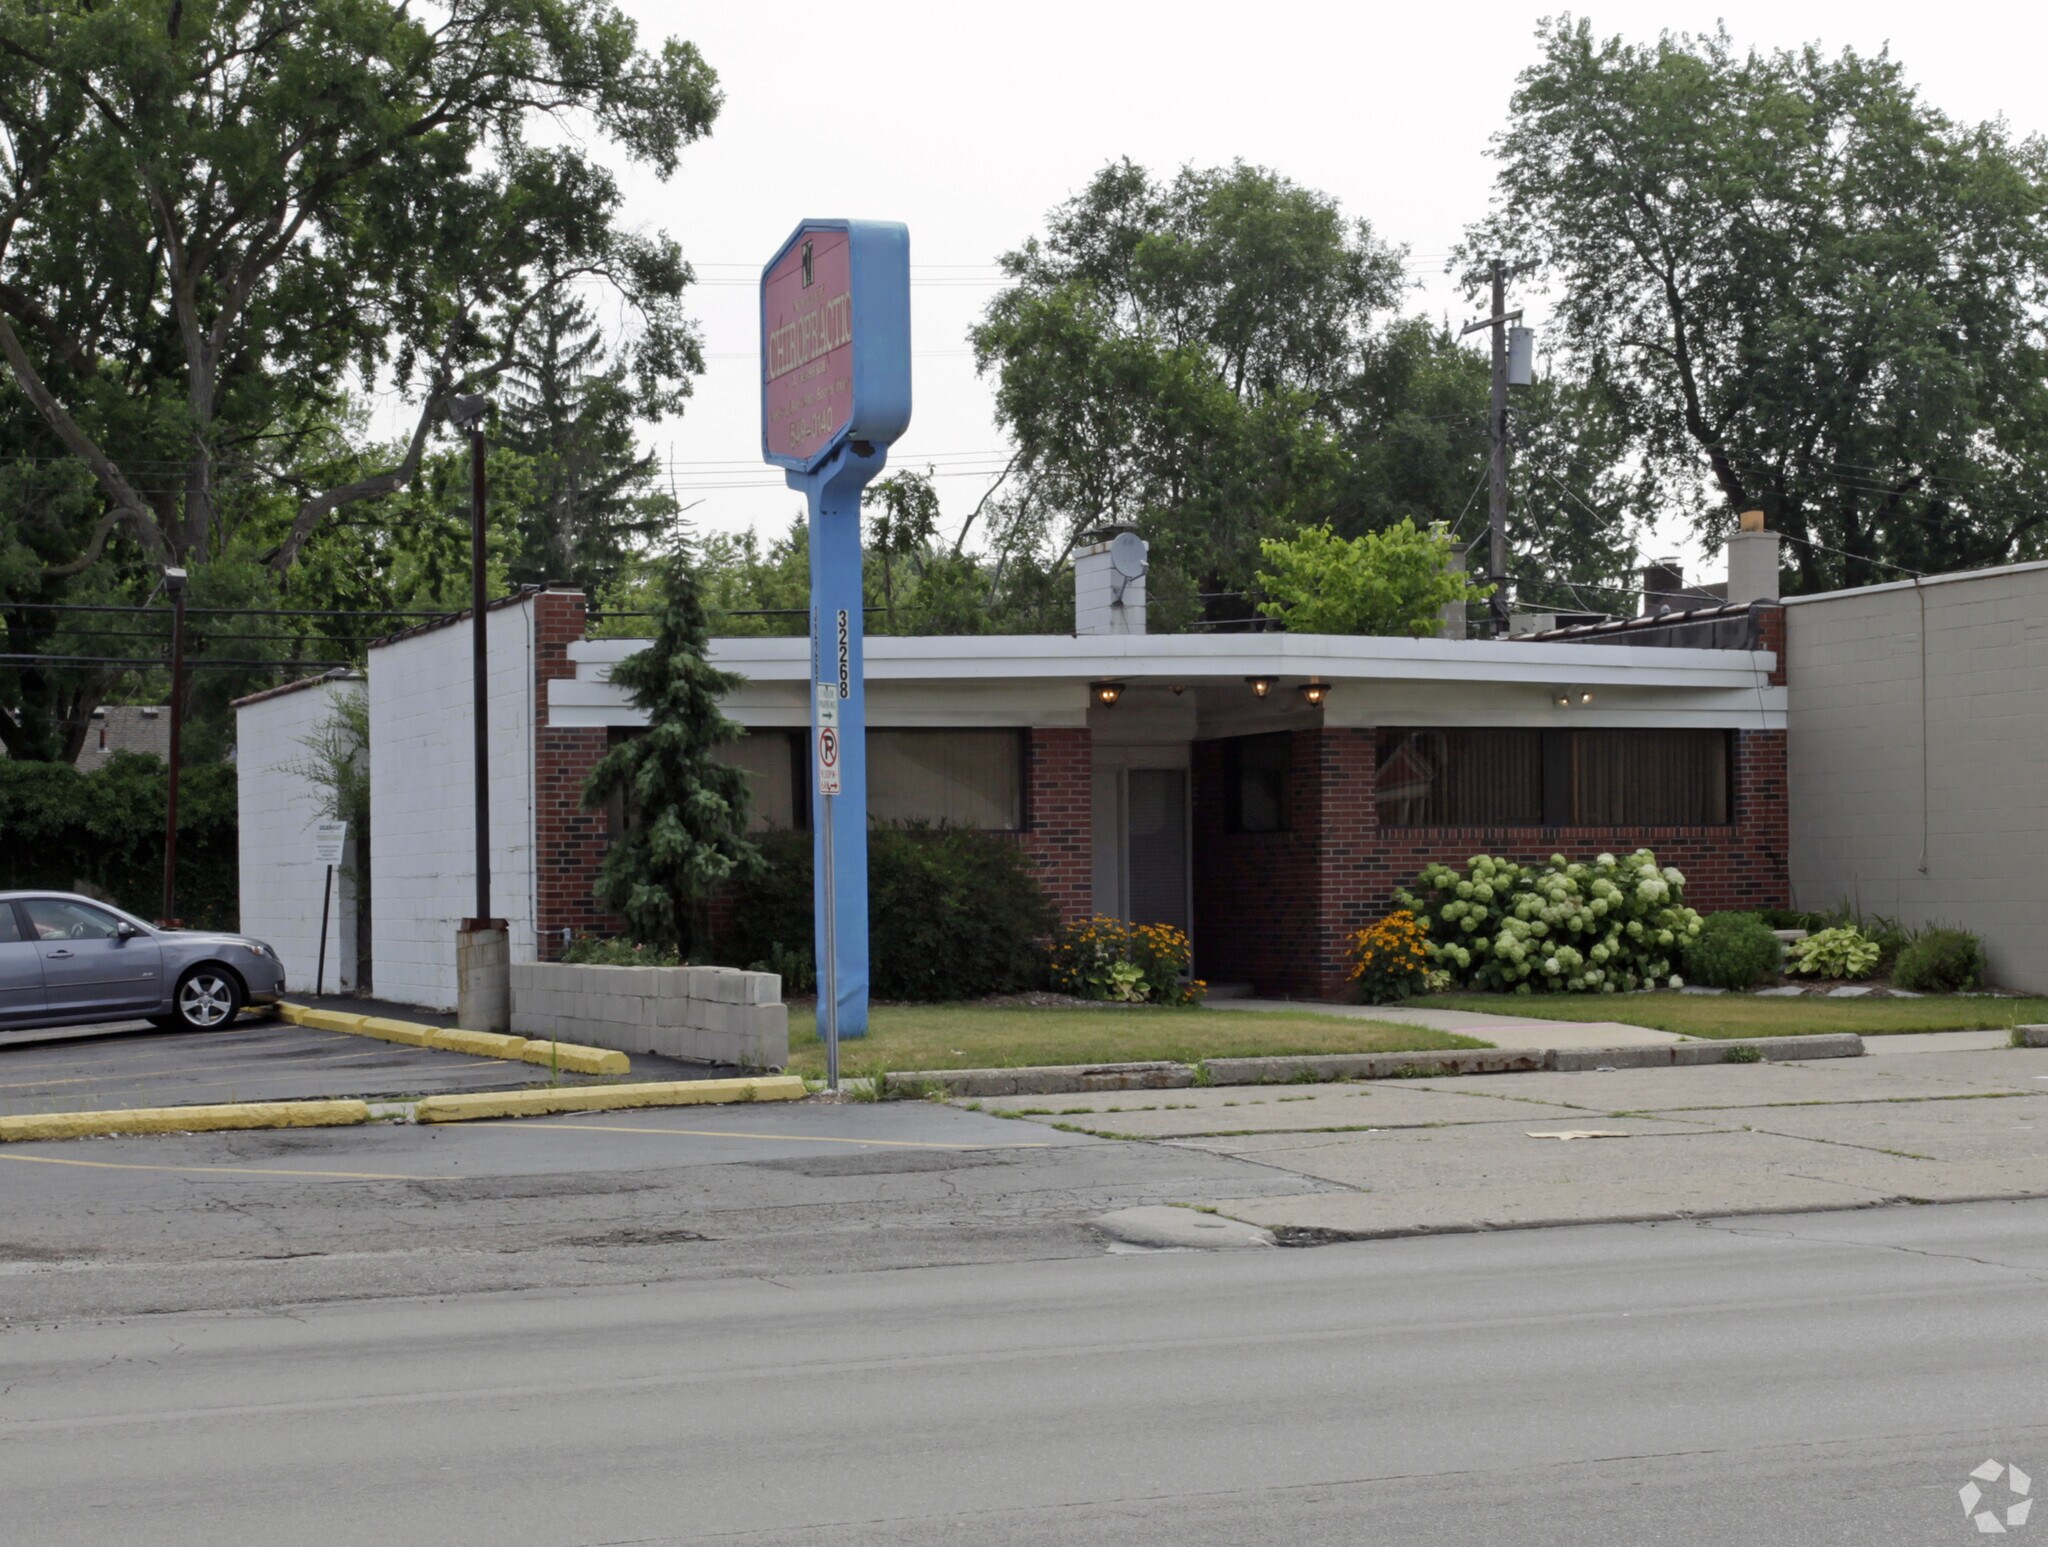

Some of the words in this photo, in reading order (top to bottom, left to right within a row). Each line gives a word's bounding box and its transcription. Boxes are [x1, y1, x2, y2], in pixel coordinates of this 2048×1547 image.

[769, 290, 852, 379] CHIROPRACTIC
[790, 407, 833, 448] 549-0140
[839, 611, 848, 698] 32268
[818, 699, 836, 710] PARKING
